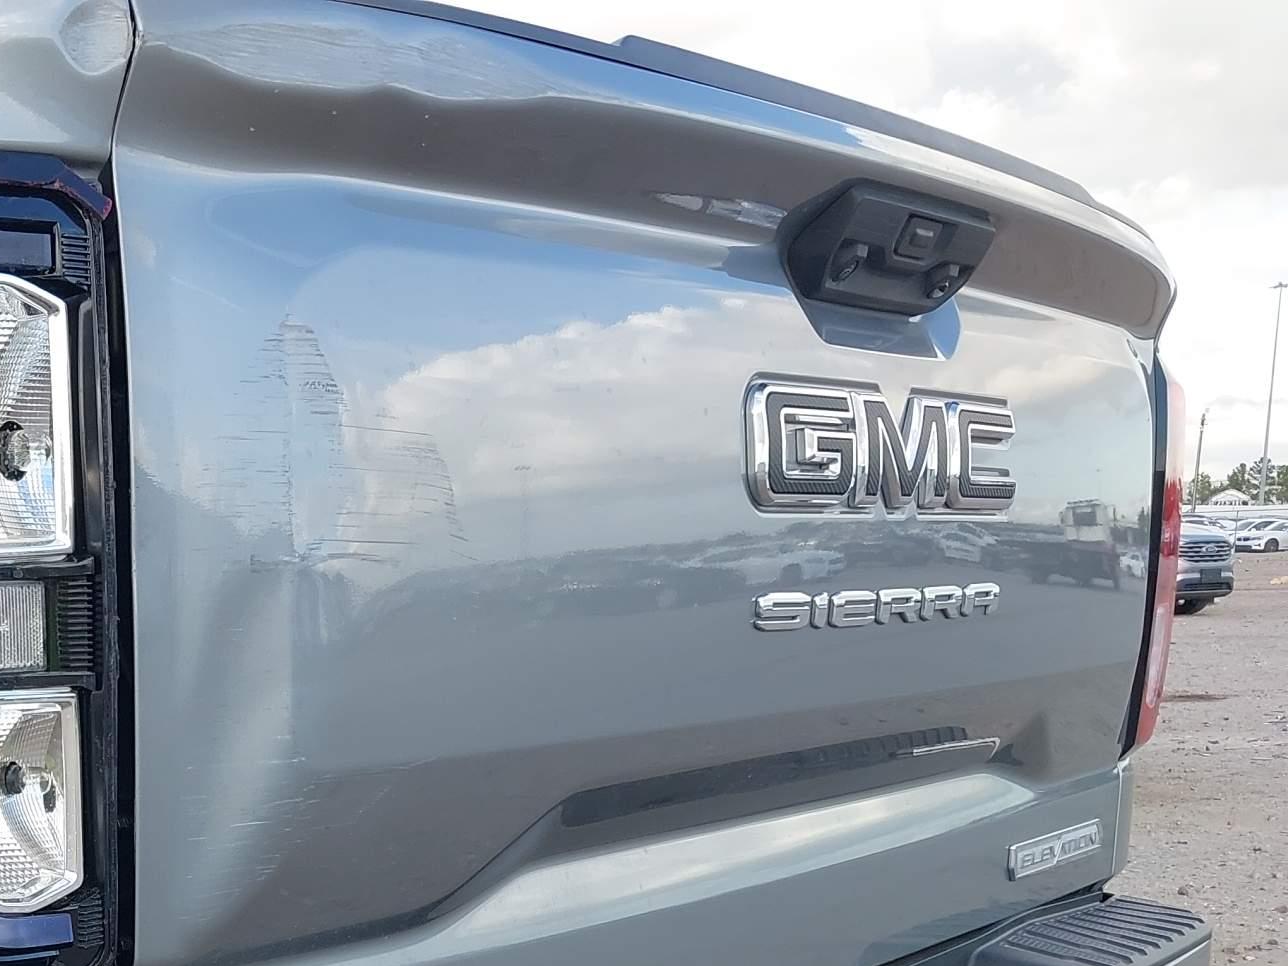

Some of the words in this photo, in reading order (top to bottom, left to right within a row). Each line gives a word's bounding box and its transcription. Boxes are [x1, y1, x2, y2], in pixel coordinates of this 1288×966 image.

[743, 372, 1016, 520] GMC
[753, 582, 1001, 630] SIERRA
[1020, 830, 1098, 870] ELEVATION
